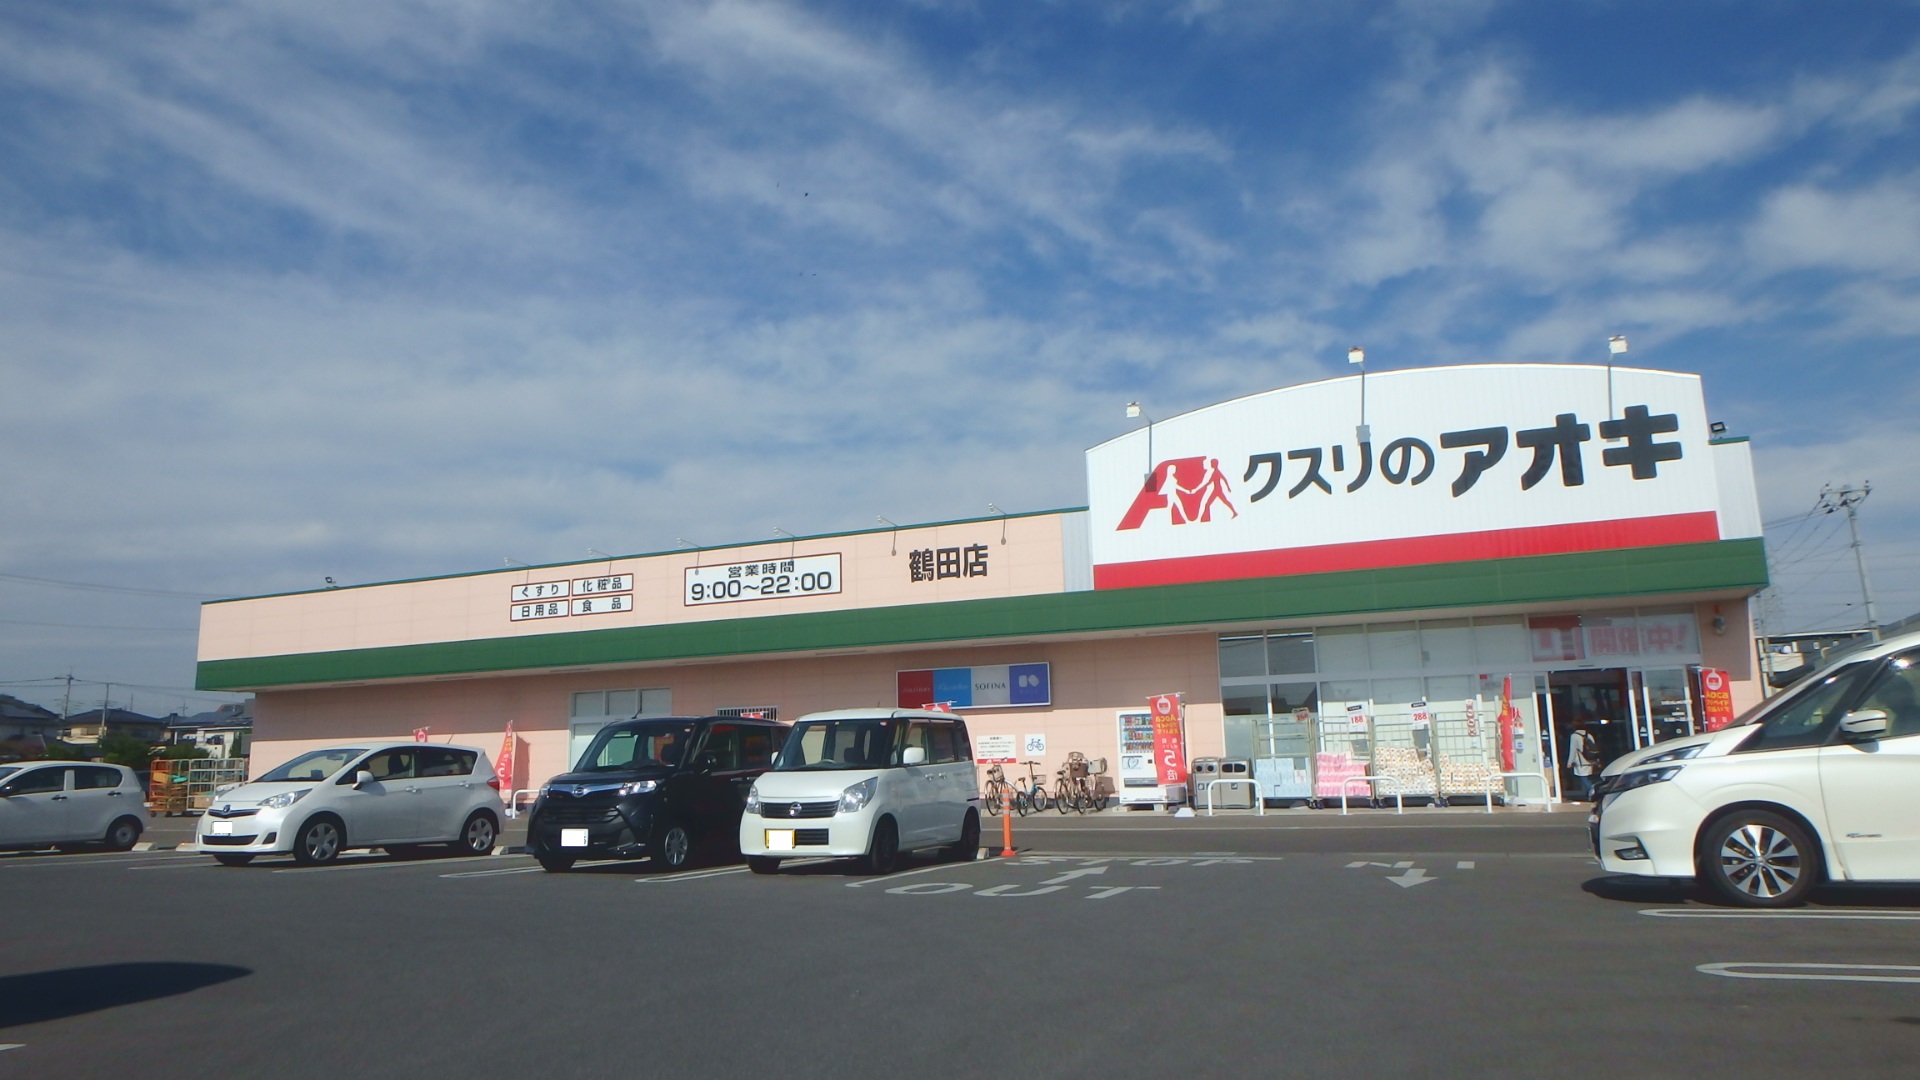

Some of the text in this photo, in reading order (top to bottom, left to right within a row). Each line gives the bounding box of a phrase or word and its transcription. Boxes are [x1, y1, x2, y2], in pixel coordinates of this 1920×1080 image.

[1243, 404, 1683, 502] クスリのアオキ
[728, 561, 795, 579] 営業時間
[908, 543, 988, 583] 鶴田店
[521, 584, 559, 597] くすり
[582, 577, 622, 592] 化粧品
[521, 603, 558, 617] 日用品
[975, 682, 1006, 690] SOFINA
[1350, 715, 1364, 724] 188
[1413, 712, 1428, 721] 288
[884, 882, 1163, 900] OUT
